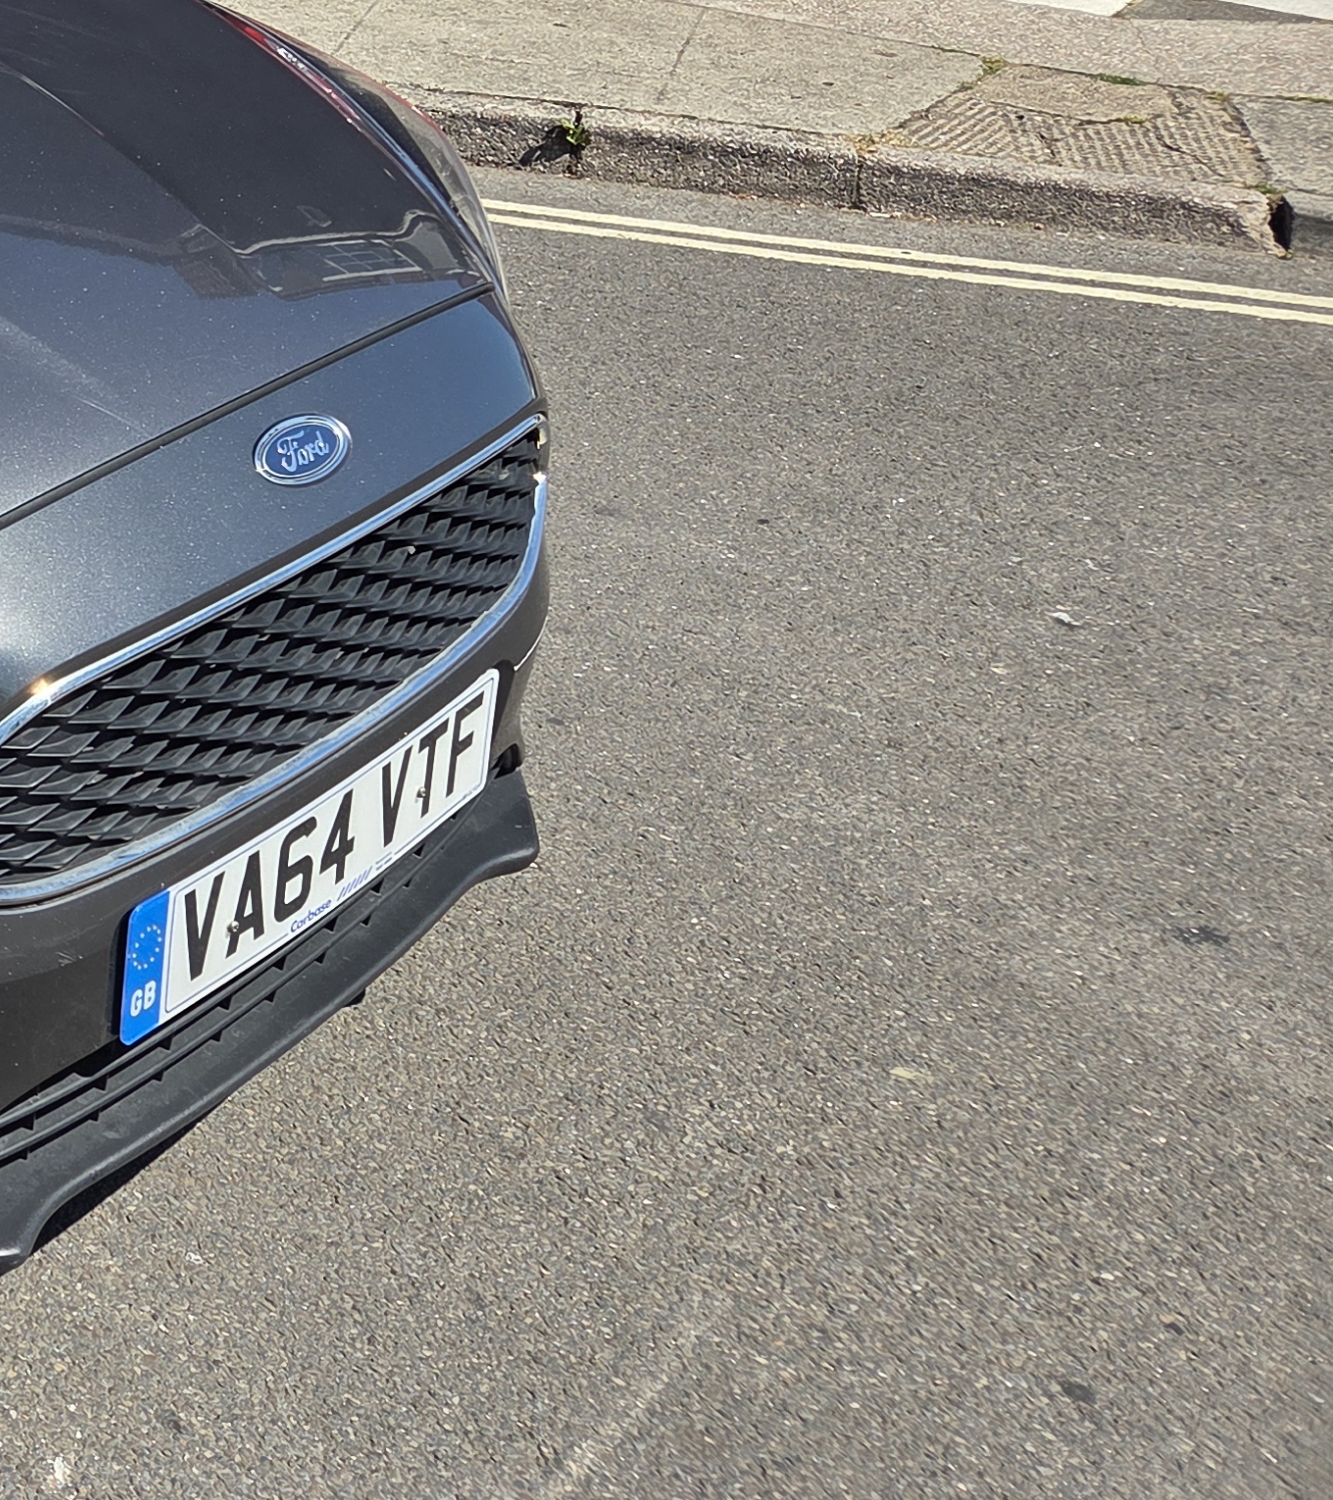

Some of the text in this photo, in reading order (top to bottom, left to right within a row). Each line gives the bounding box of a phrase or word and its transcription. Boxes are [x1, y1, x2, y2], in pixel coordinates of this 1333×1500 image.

[276, 430, 330, 472] Ford
[184, 691, 486, 982] VA64 VTF
[130, 982, 157, 1017] GB
